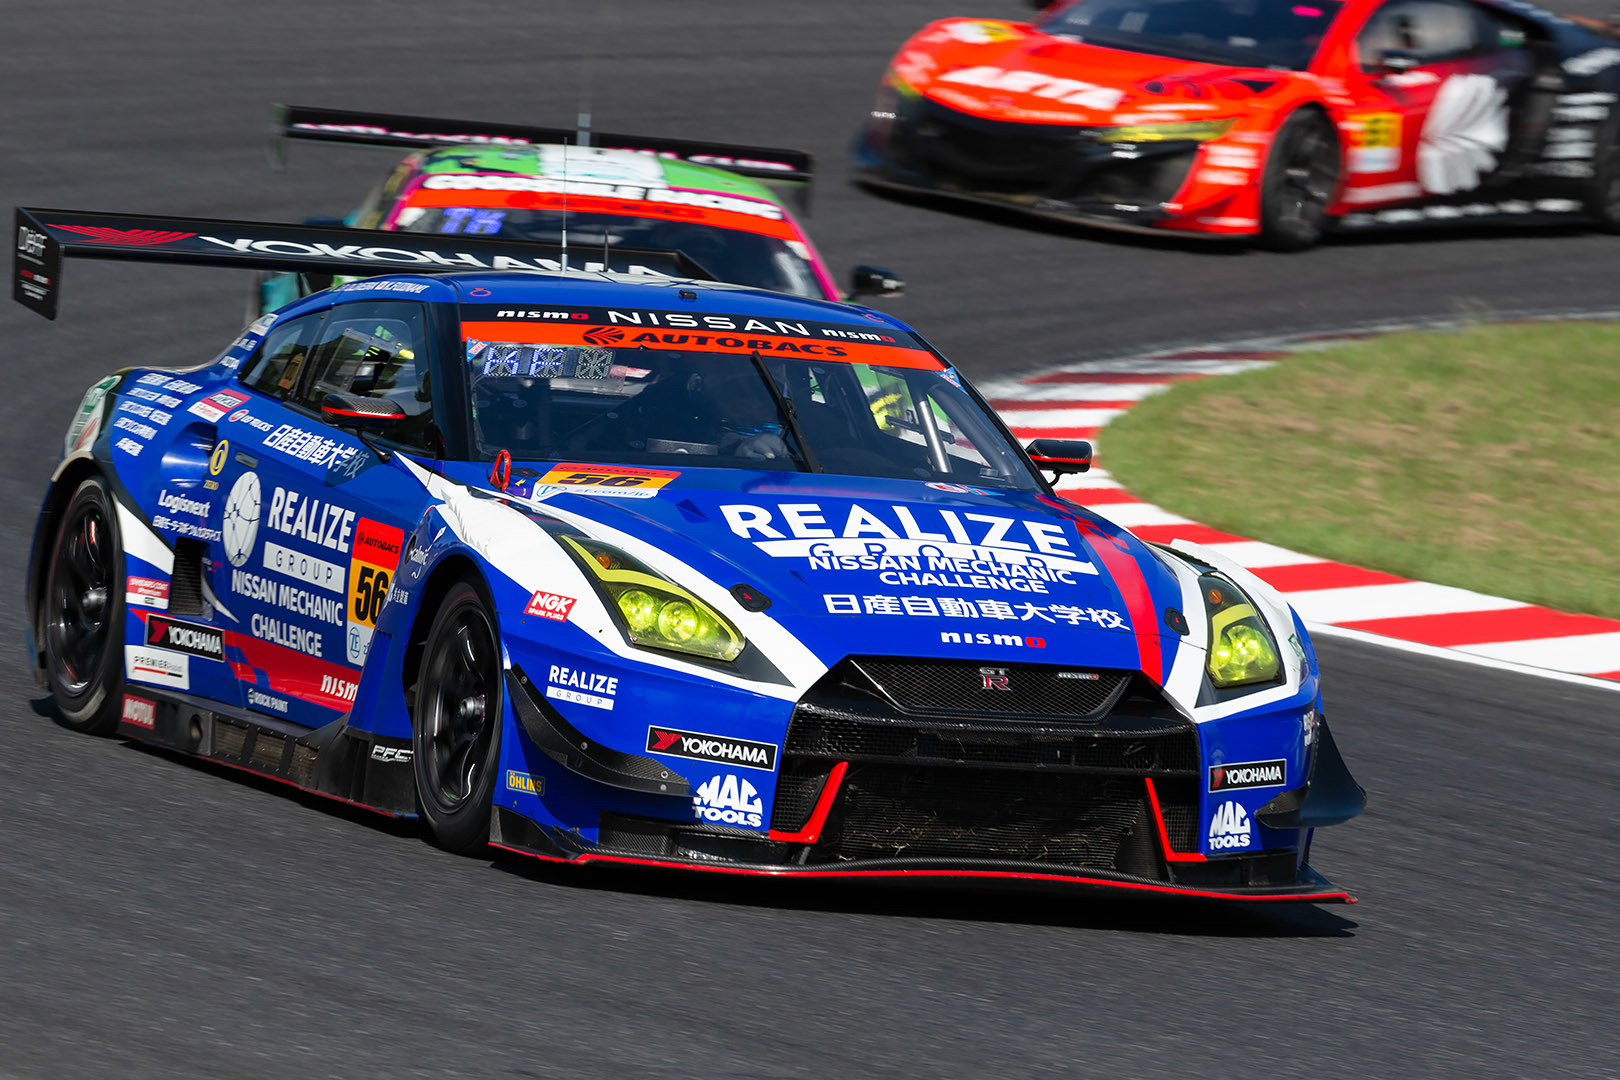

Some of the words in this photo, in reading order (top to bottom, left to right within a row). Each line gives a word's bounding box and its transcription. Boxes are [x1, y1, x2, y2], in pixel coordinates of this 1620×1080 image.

[496, 310, 590, 320] nismo
[608, 310, 811, 337] NISSAN
[821, 328, 896, 343] nismo
[631, 332, 848, 357] AUTOBACS
[557, 473, 652, 487] 56
[267, 487, 356, 554] REALIZE
[719, 503, 1077, 557] REALIZE
[363, 536, 400, 555] AUTOBACS
[275, 550, 333, 584] GROUP
[808, 556, 922, 571] NISSAN
[927, 556, 1078, 585] MECHANIC
[355, 566, 389, 625] 56
[879, 571, 1050, 594] CHALLENGE
[231, 569, 277, 601] NISSAN
[279, 584, 344, 627] MECHANIC
[531, 592, 573, 614] NGK
[823, 594, 1131, 631] 日産自動車大学校
[528, 607, 545, 617] SPARK
[546, 610, 565, 621] PLUGS
[168, 625, 223, 654] YOKOHAMA
[251, 613, 323, 658] CHALLENGE
[940, 632, 1046, 649] nismo
[548, 665, 619, 696] REALIZE
[1058, 672, 1099, 681] nismo
[556, 689, 603, 705] GROUP
[681, 736, 769, 765] YOKOHAMA
[508, 772, 543, 793] ÖHLINS
[1225, 765, 1282, 785] YOKOHAMA
[693, 774, 763, 815] MAC
[692, 806, 762, 828] TOOLS
[1209, 801, 1251, 837] MAC
[1208, 834, 1251, 850] TOOLS
